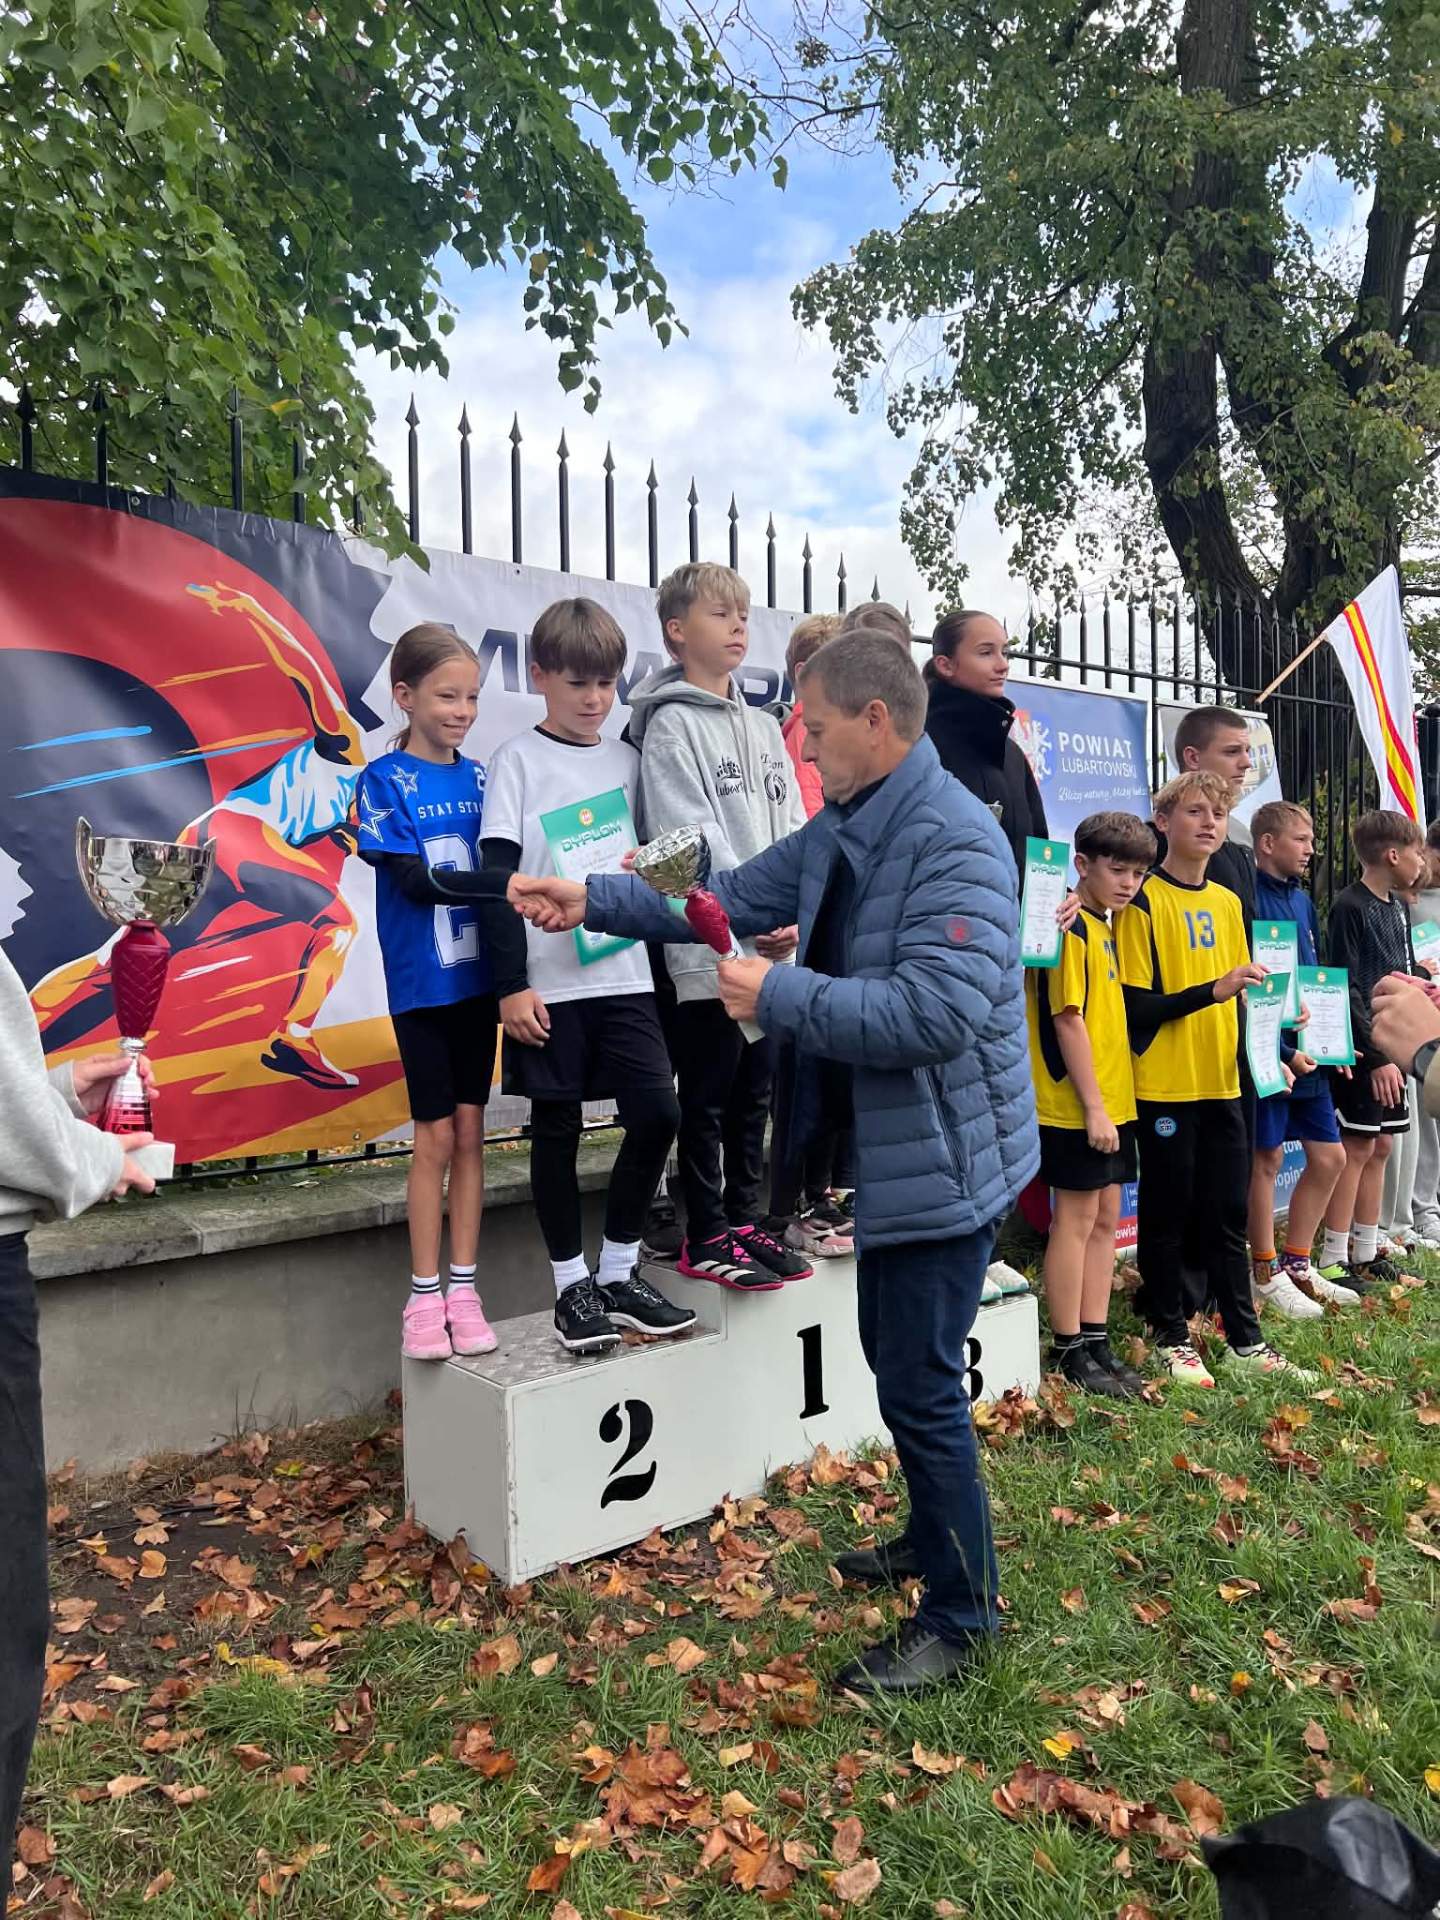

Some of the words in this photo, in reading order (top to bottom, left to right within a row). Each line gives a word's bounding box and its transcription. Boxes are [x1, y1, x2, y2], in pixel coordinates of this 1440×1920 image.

[1058, 731, 1132, 760] POWIAT
[1062, 757, 1138, 779] LUBARTOWSKI
[417, 801, 453, 819] STAY
[561, 820, 623, 853] DYPLOM
[1184, 911, 1216, 951] 13
[796, 1323, 830, 1420] 1
[599, 1399, 657, 1509] 2
